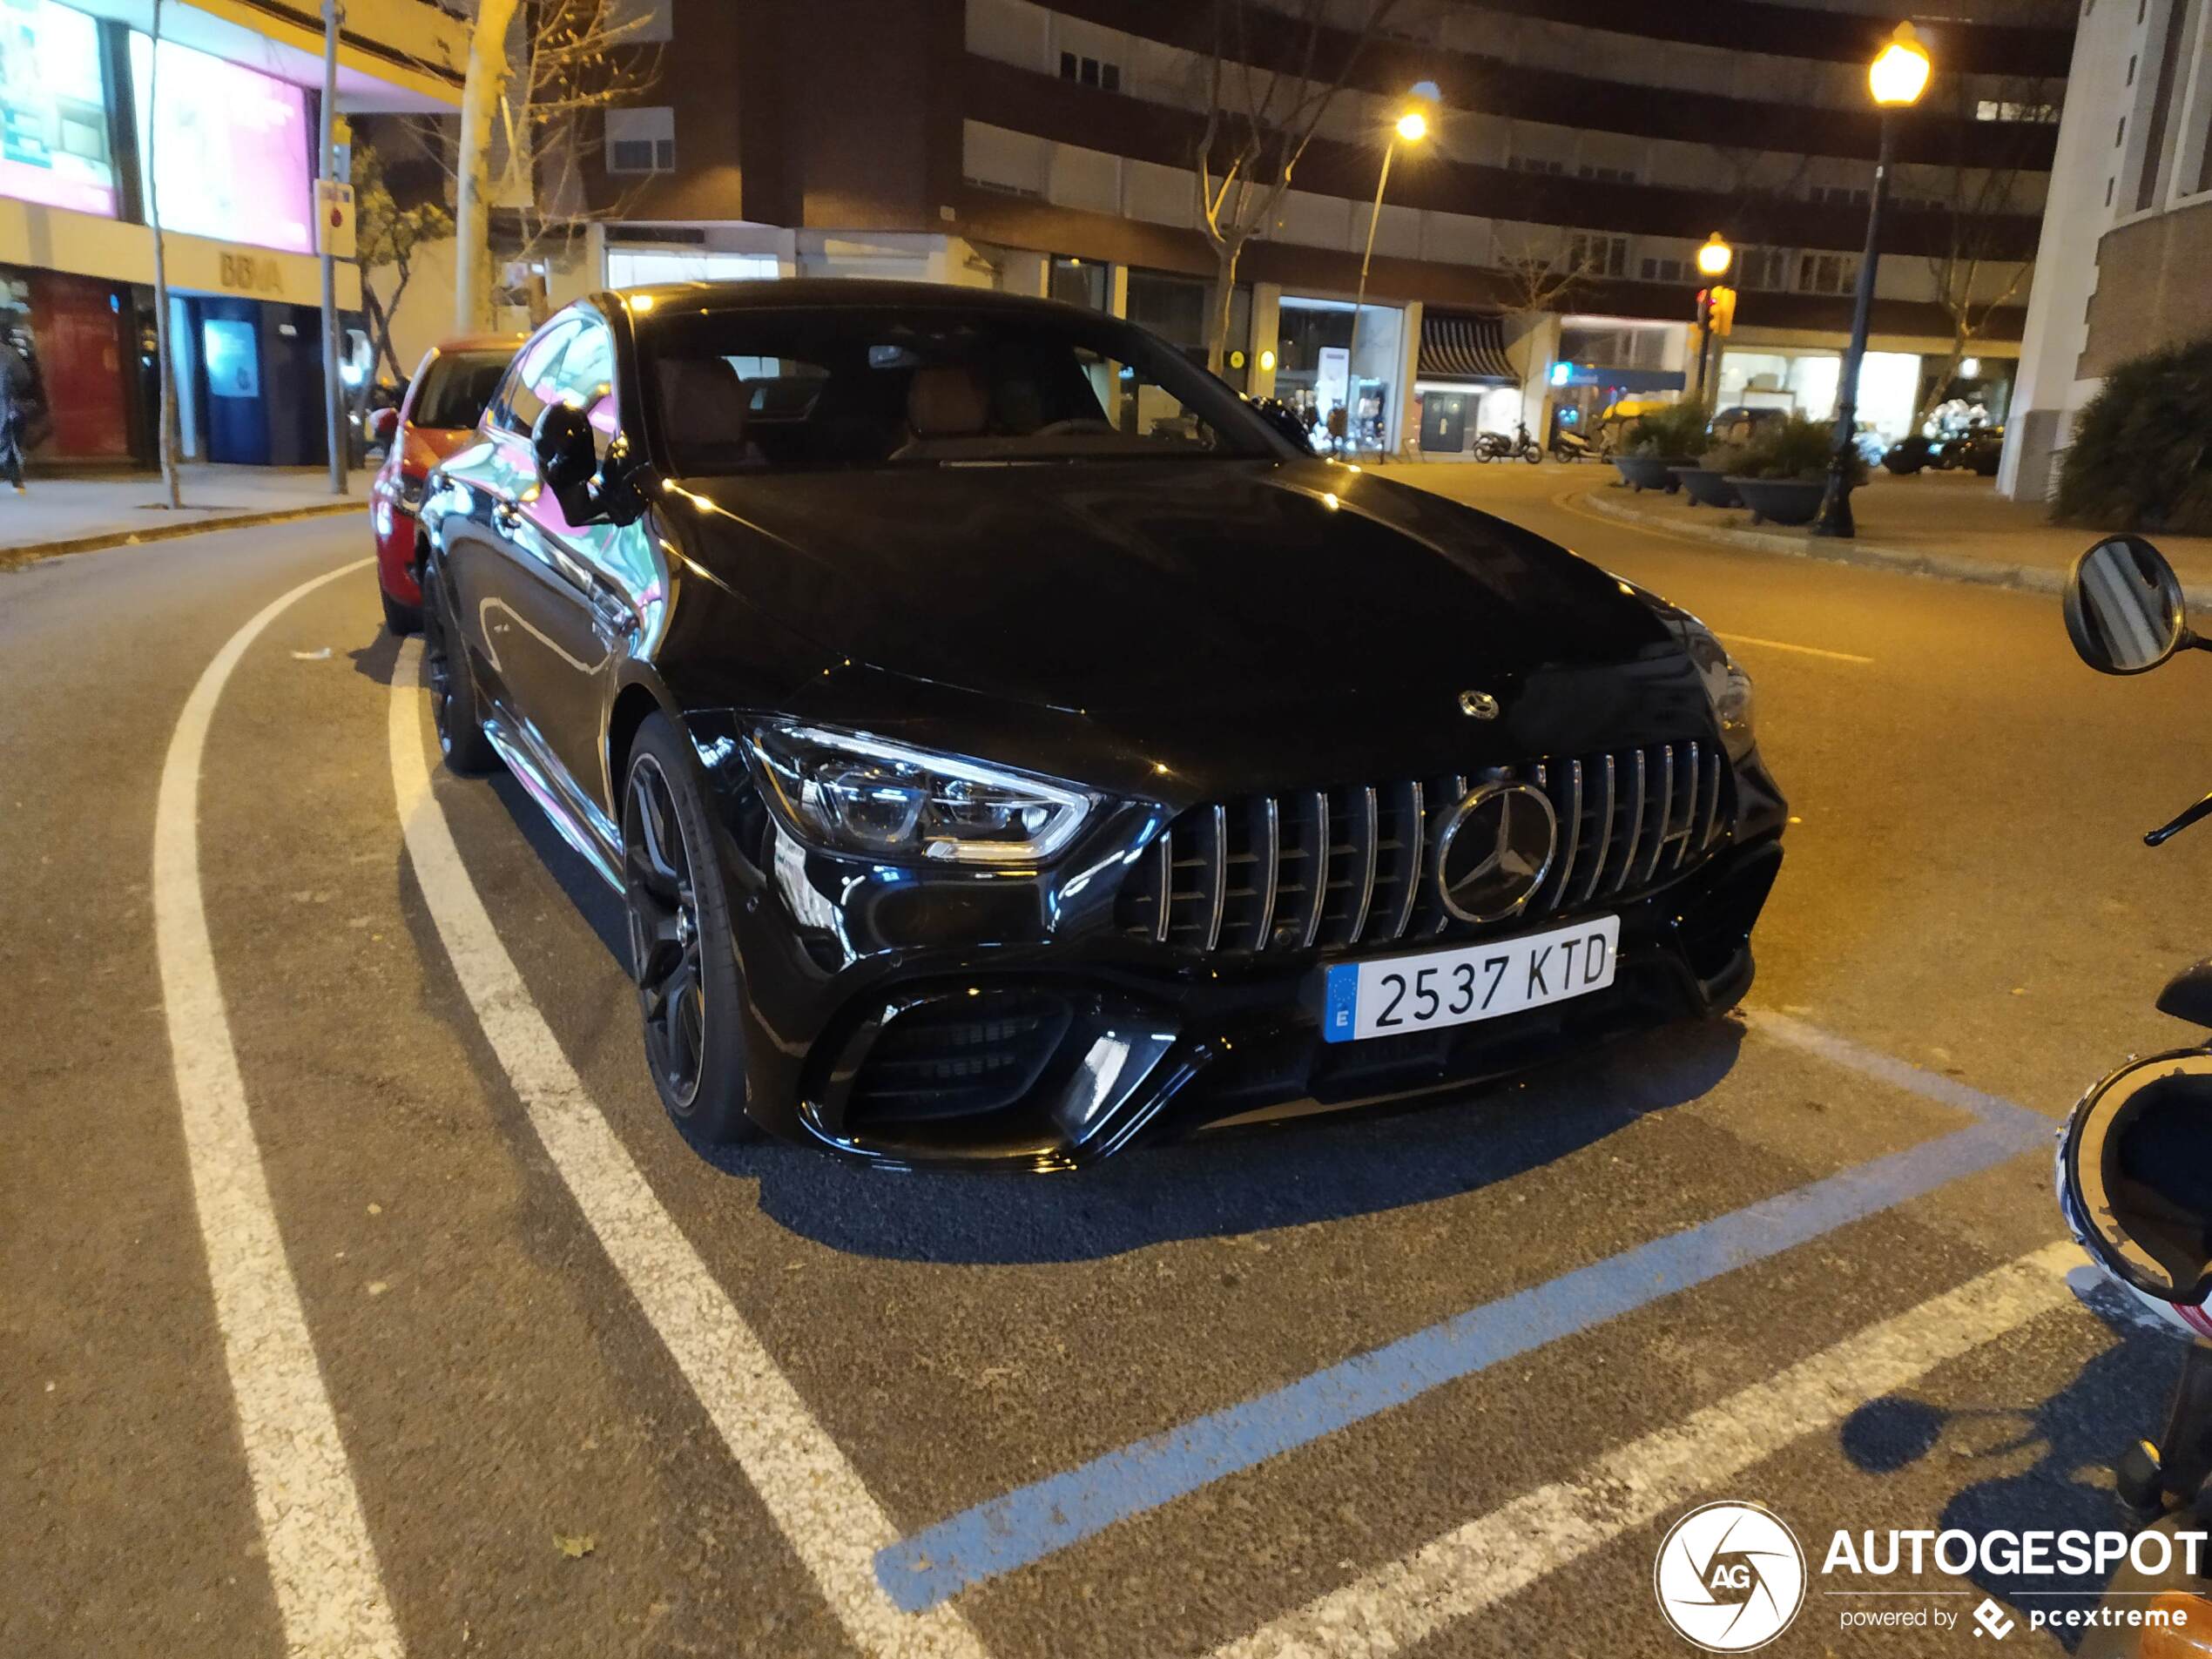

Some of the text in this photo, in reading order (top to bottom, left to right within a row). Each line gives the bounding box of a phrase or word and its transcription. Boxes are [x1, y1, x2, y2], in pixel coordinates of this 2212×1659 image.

[1376, 933, 1607, 1028] 2537 KTD
[1335, 1010, 1349, 1027] E
